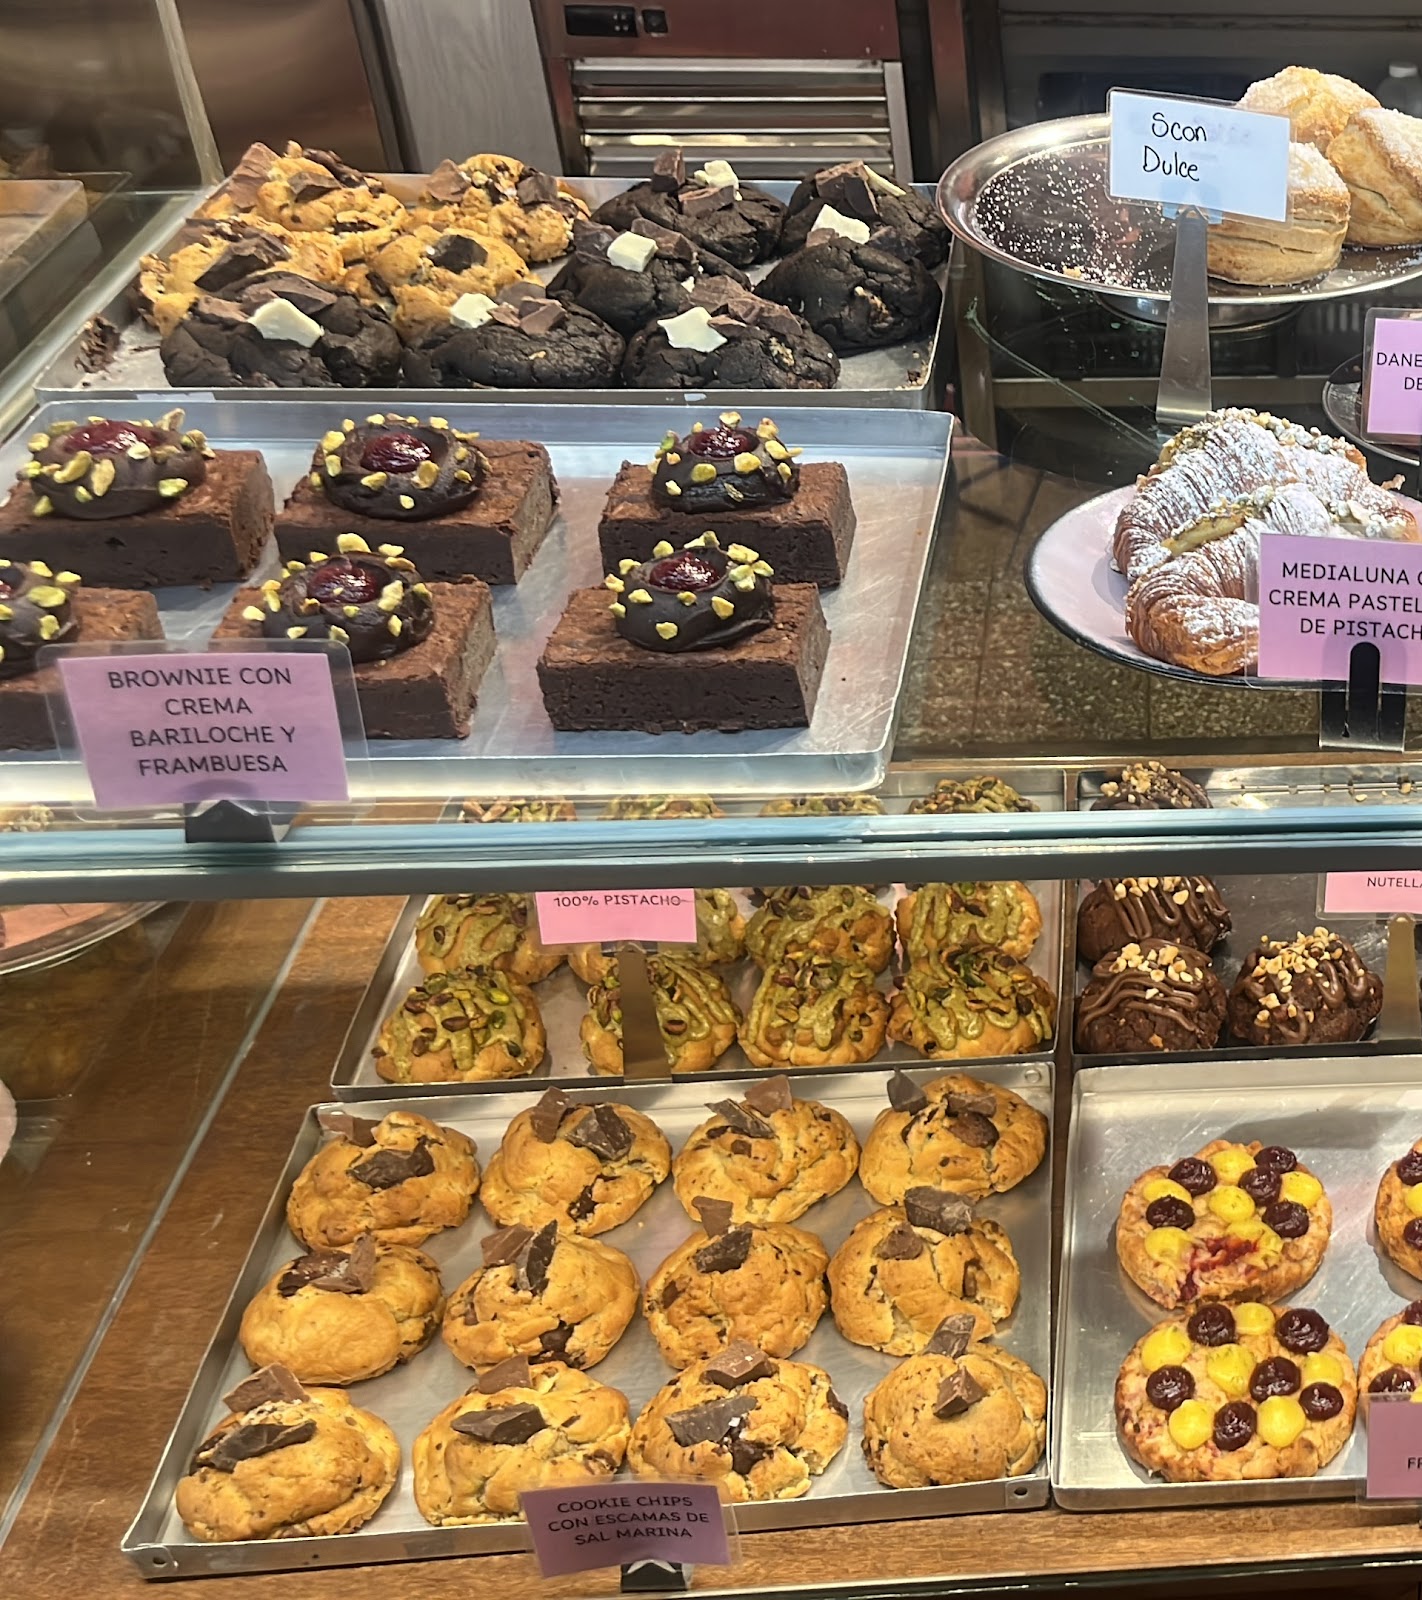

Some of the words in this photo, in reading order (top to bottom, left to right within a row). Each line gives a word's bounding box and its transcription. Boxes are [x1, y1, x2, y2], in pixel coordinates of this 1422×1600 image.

[1151, 112, 1208, 142] Scon
[1142, 145, 1200, 181] Dulce
[1282, 562, 1410, 586] MEDIALUNA
[1269, 589, 1340, 608] CREMA
[1300, 618, 1326, 635] DE
[107, 667, 232, 689] BROWNIE
[240, 667, 292, 685] CON
[165, 697, 252, 716] CREMA
[130, 726, 274, 747] BARILOCHE
[280, 726, 296, 743] Y
[138, 755, 288, 776] FRAMBUESA
[554, 896, 599, 907] 100%
[604, 895, 681, 906] PISTACHO
[557, 1497, 631, 1513] COOKIE
[637, 1496, 693, 1507] CHIPS
[548, 1517, 589, 1532] CON
[596, 1511, 681, 1525] ESCAMAS
[687, 1511, 709, 1523] DE
[574, 1532, 611, 1545] SAL
[616, 1527, 692, 1539] MARINA
